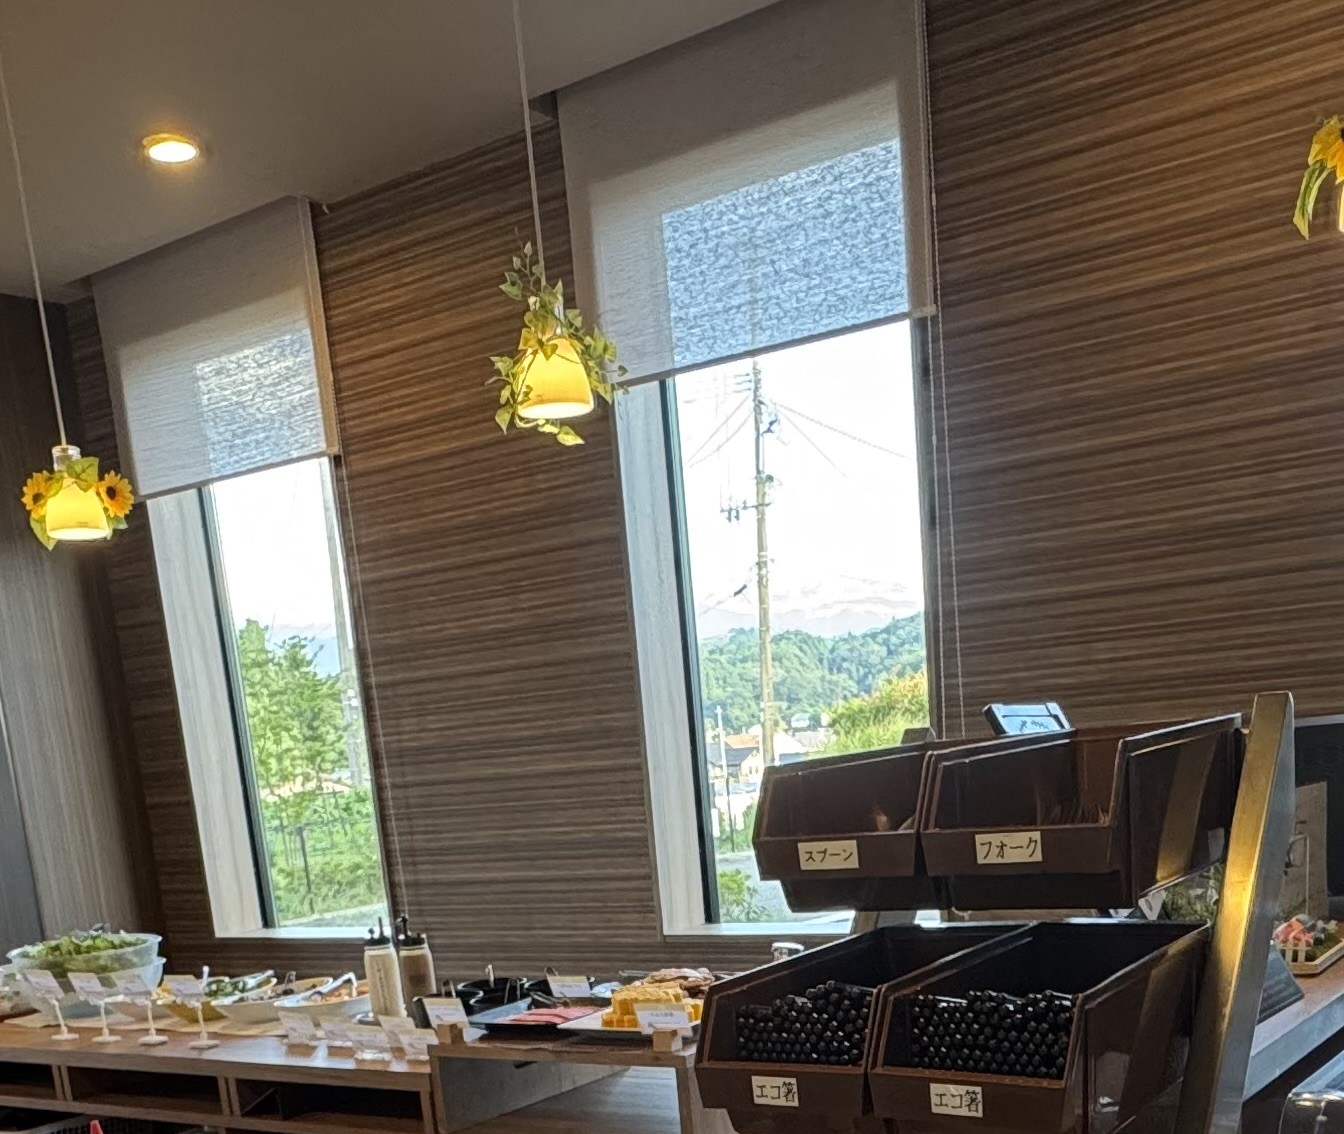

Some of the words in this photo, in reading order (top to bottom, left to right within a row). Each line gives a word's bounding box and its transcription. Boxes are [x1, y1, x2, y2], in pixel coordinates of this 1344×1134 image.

[979, 836, 1038, 859] フォーク
[755, 1080, 797, 1103] エコ箸
[933, 1089, 981, 1113] エコ箸
